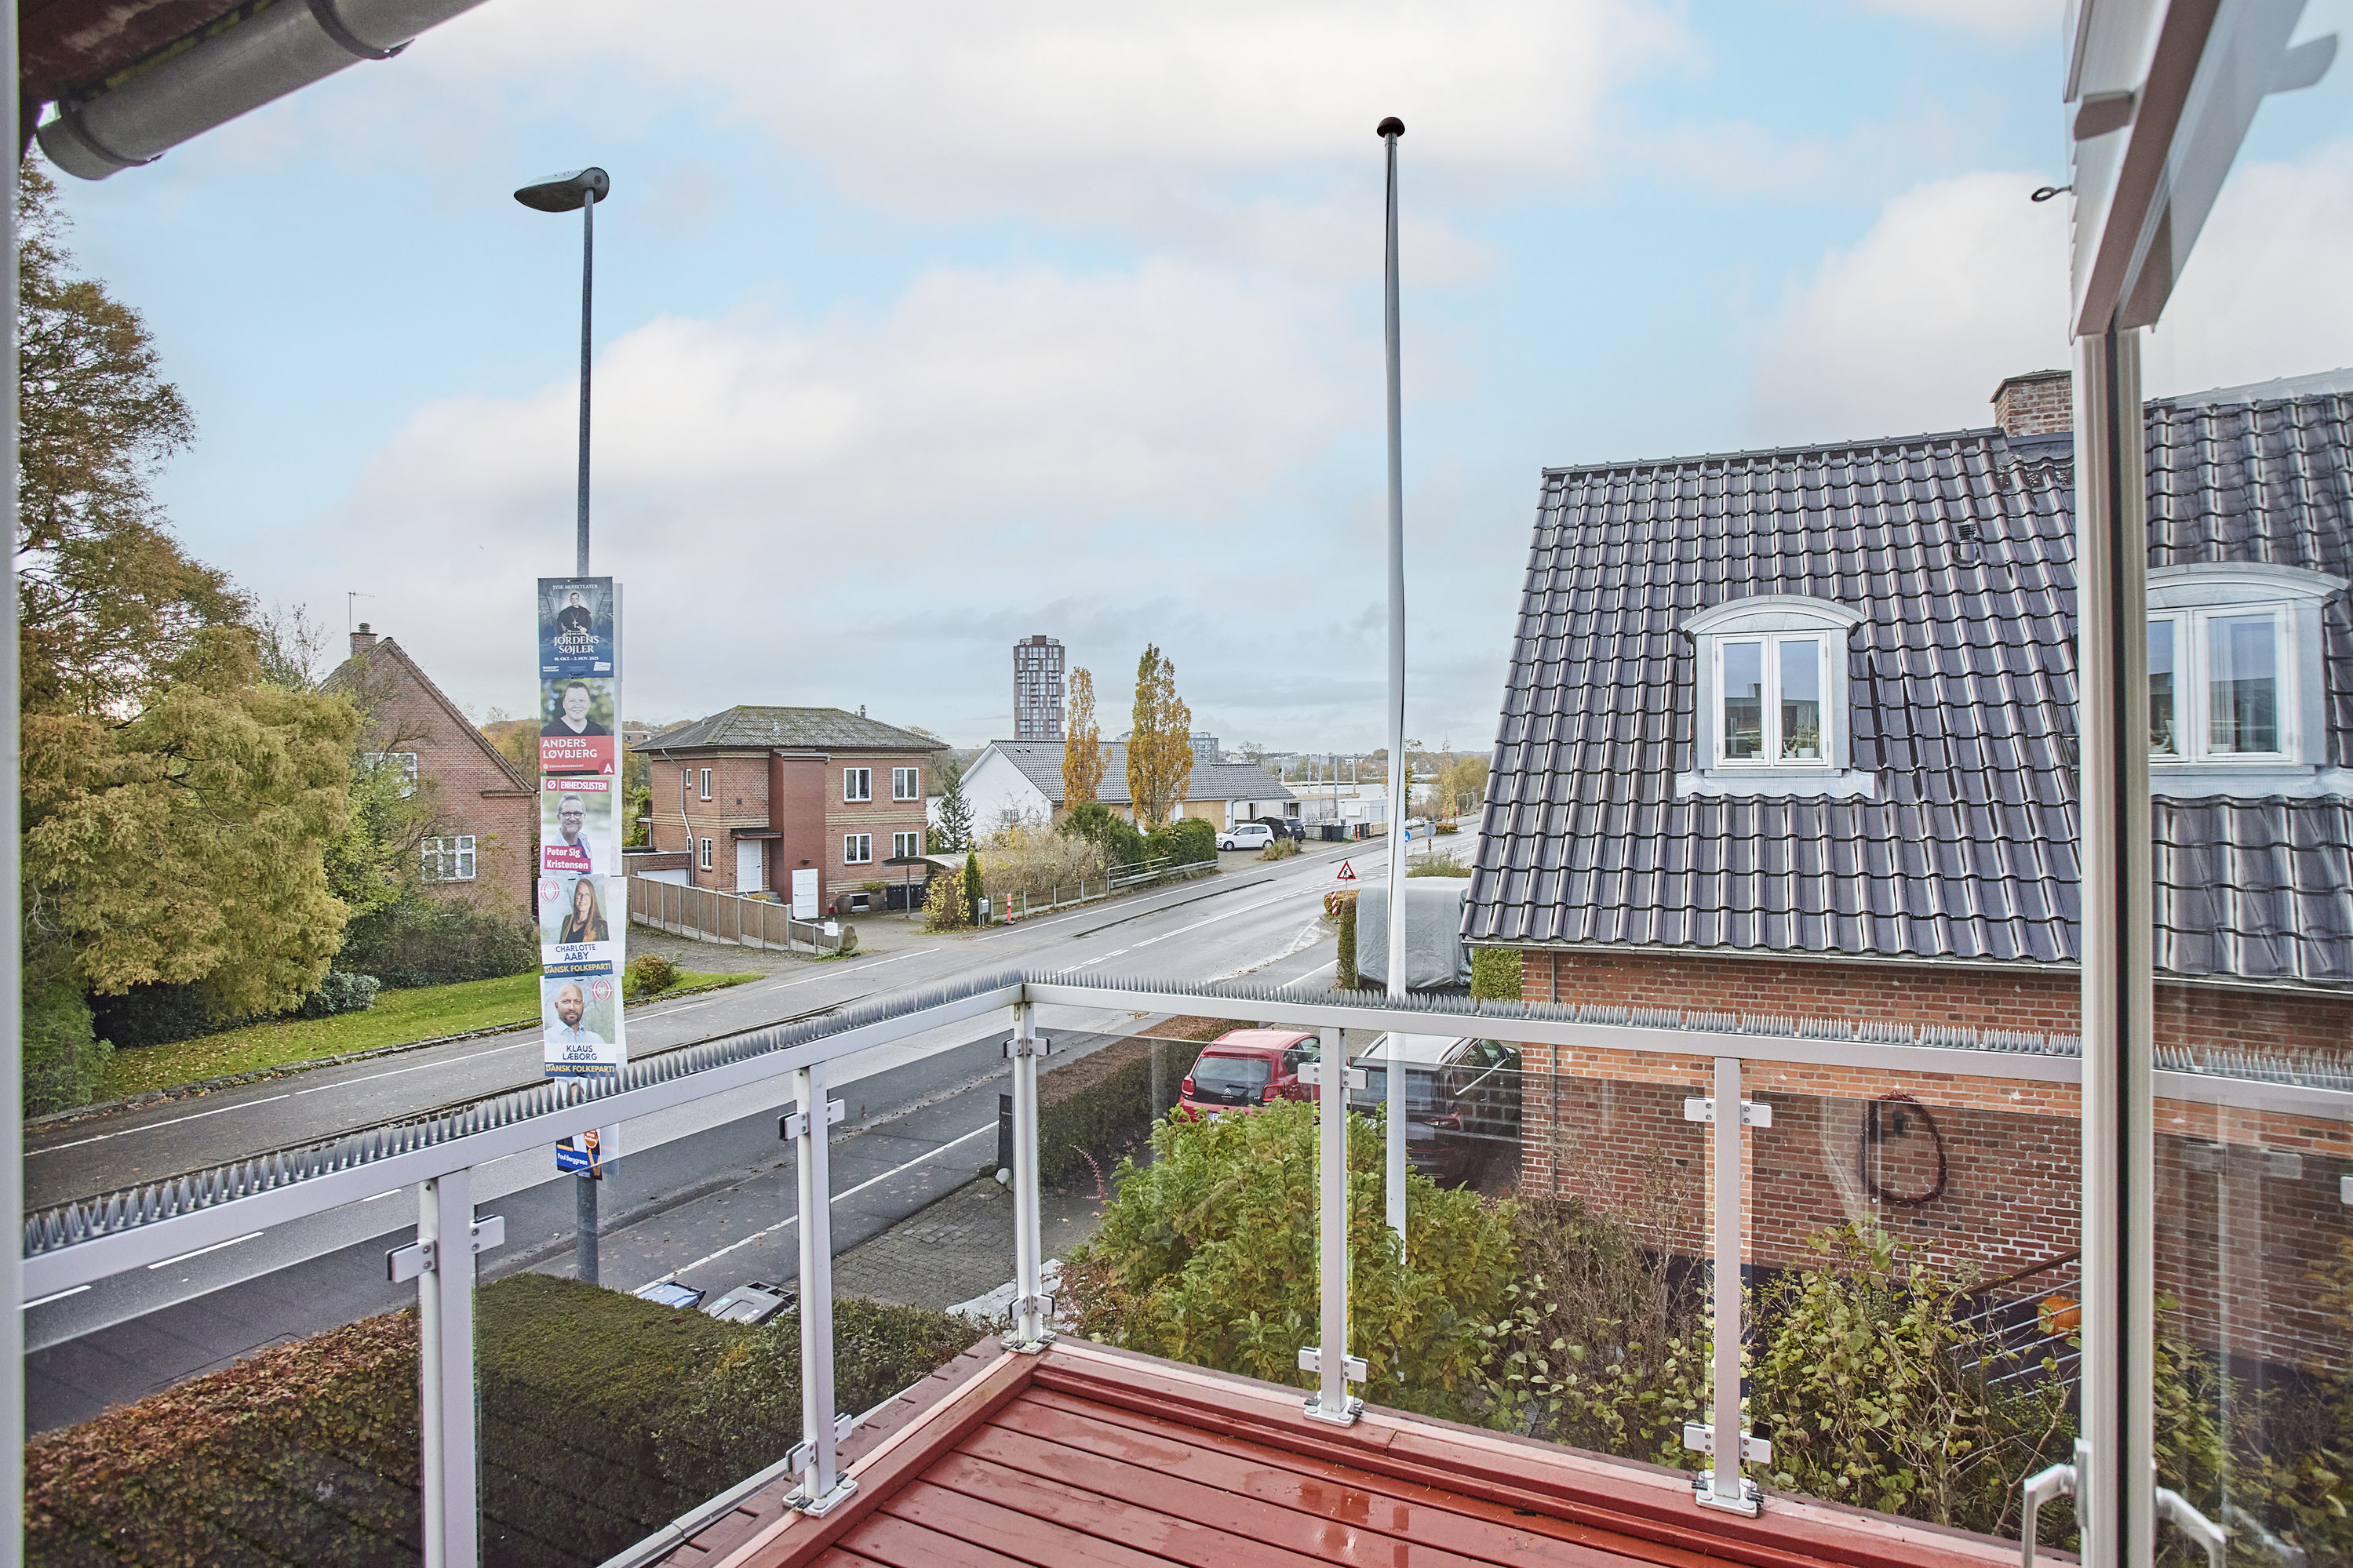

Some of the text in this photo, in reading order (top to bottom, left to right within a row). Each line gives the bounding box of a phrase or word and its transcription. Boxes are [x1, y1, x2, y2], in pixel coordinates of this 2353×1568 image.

[554, 635, 599, 646] JORDENS
[559, 645, 595, 655] SØJLER
[542, 739, 587, 748] ANDERS
[543, 749, 597, 759] LØVBJERG
[603, 762, 613, 773] A
[560, 780, 607, 791] ENHEDSLISTEN
[547, 847, 581, 858] Peter Sig
[546, 860, 588, 869] Kristensen
[555, 944, 596, 952] CHARLOTTE
[564, 951, 589, 961] AABY
[570, 963, 611, 972] FOLKEPARTI
